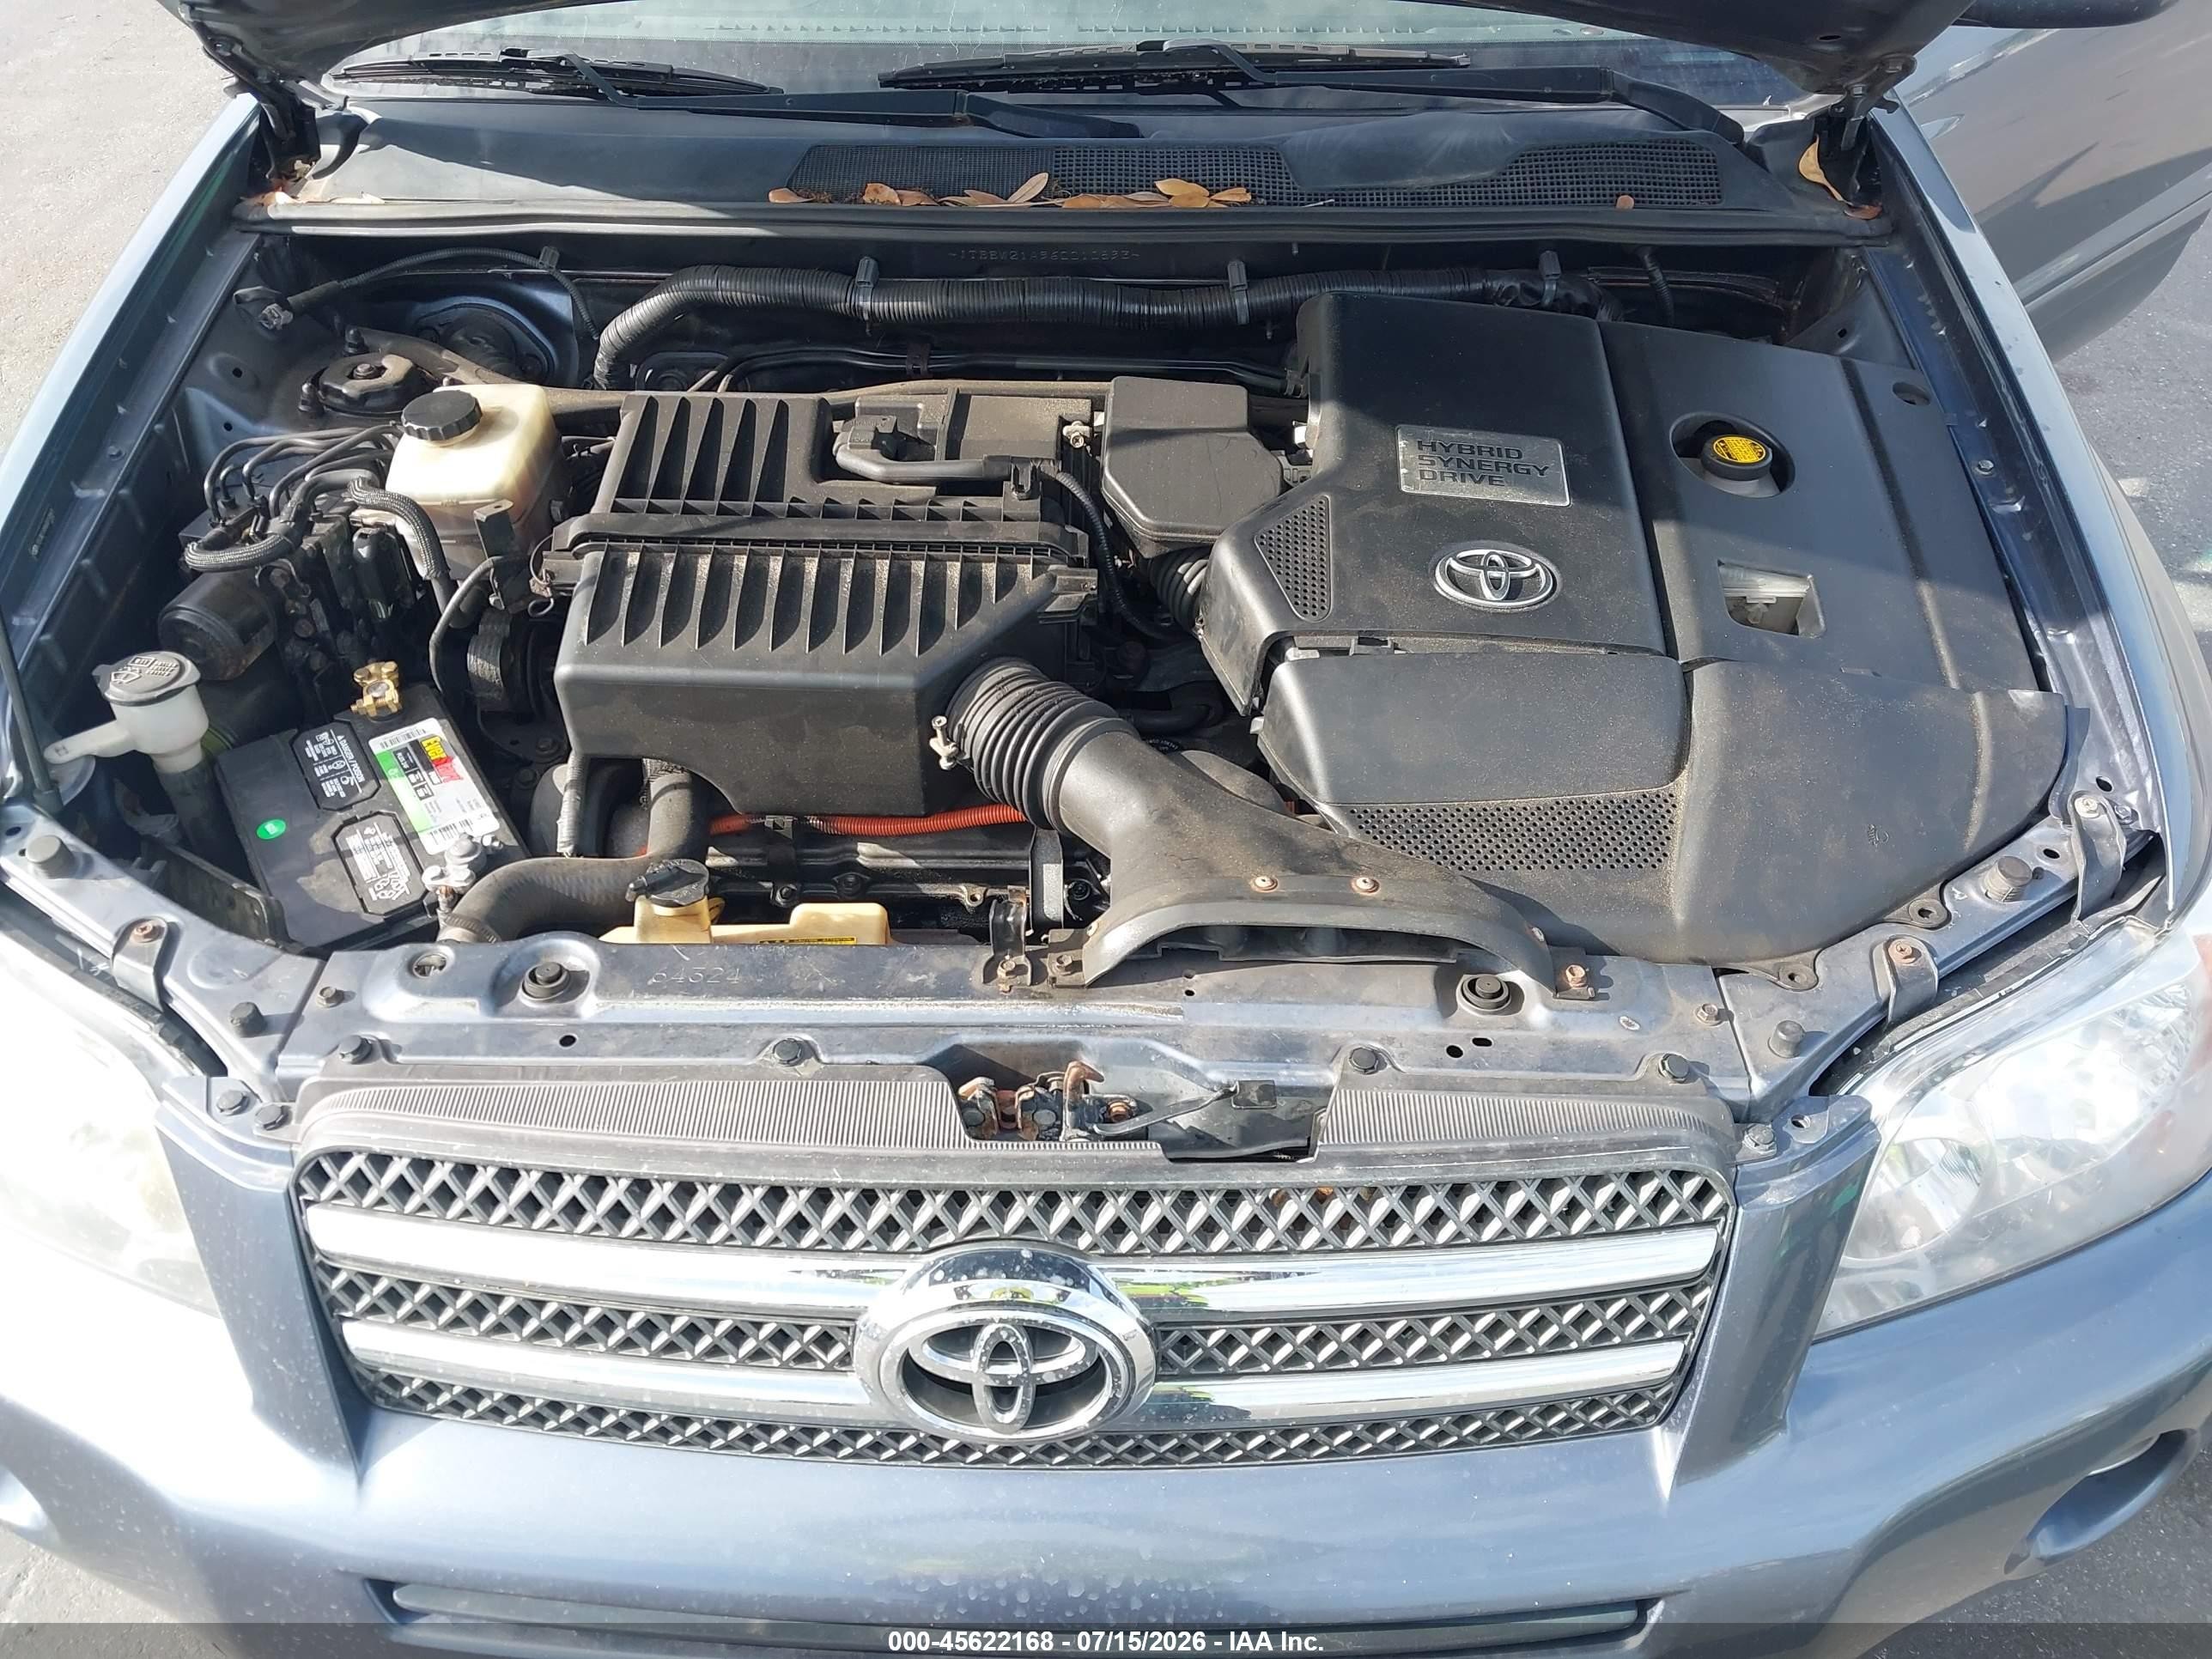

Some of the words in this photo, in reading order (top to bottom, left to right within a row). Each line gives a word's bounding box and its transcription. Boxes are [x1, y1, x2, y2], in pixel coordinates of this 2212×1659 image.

[1418, 440, 1523, 459] HYBRID
[1418, 454, 1550, 477] SYNERGY
[1419, 469, 1505, 487] DRIVE
